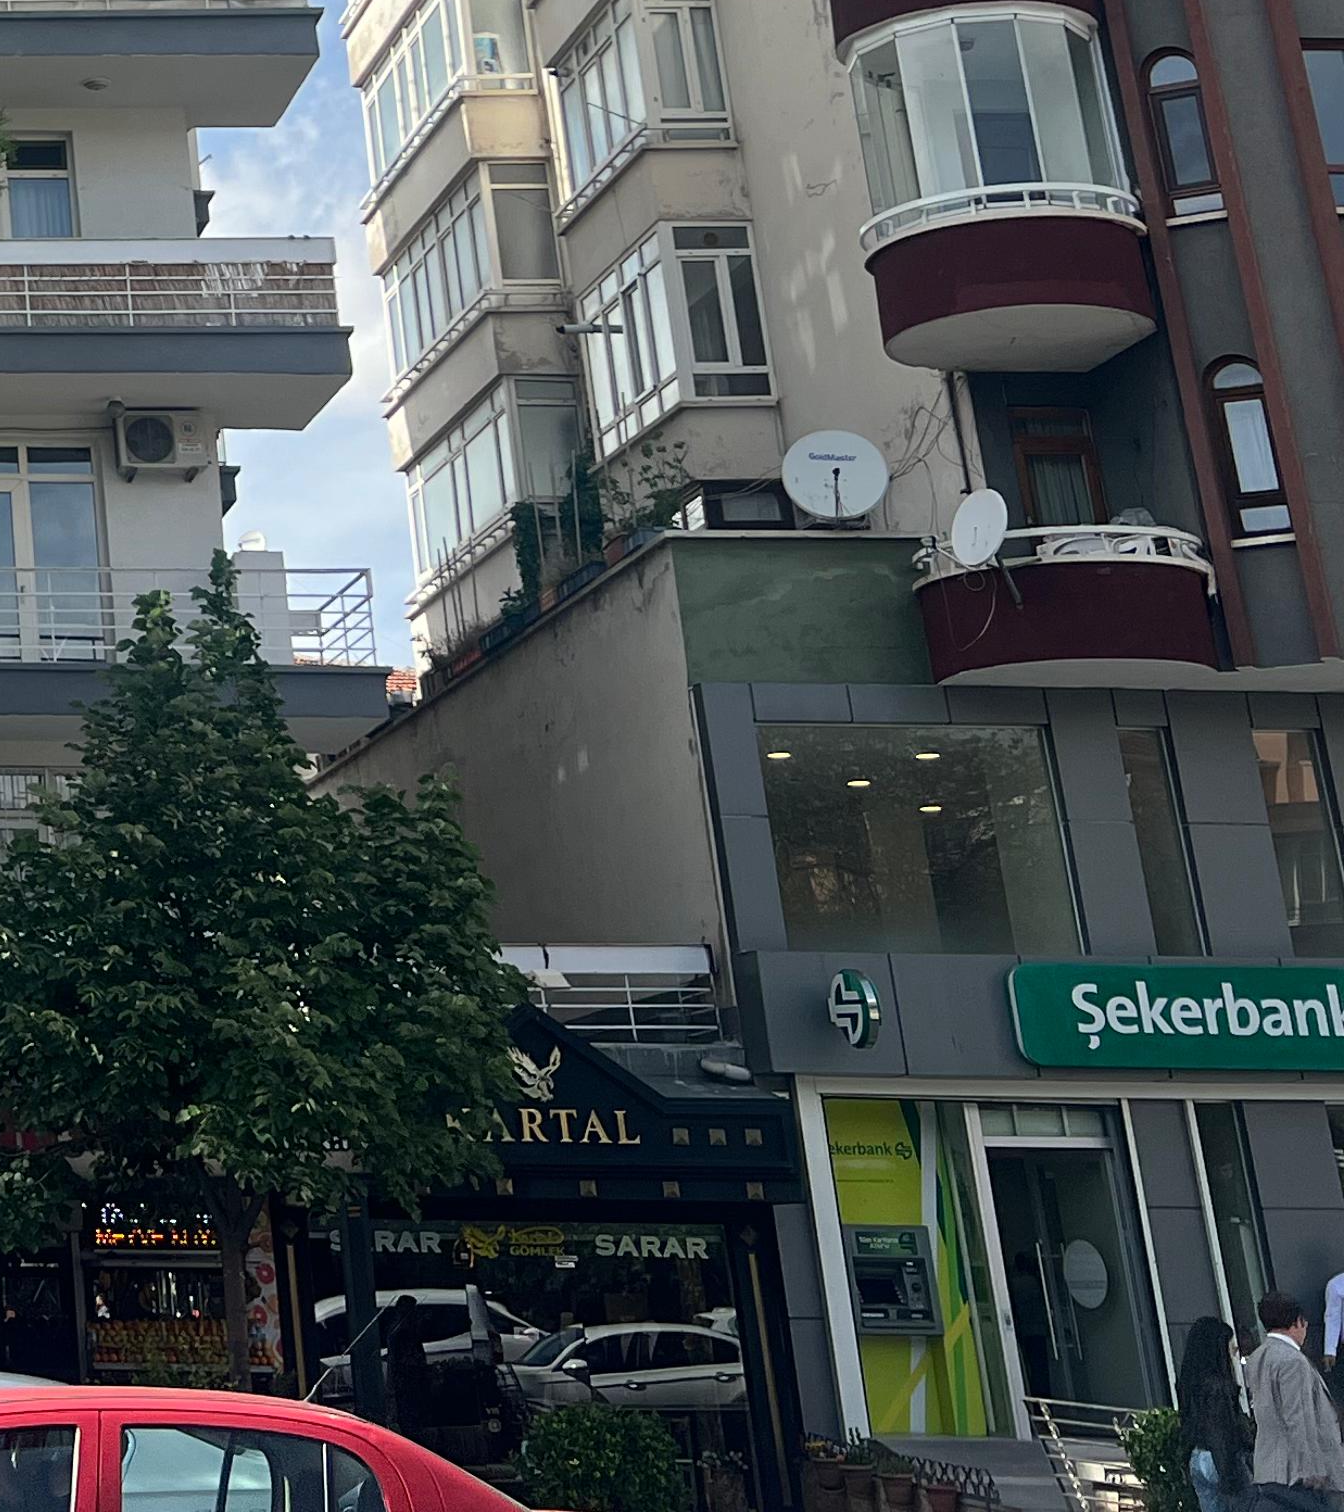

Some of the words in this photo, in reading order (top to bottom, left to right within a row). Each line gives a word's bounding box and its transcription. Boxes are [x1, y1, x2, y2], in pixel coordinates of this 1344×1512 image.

[1071, 981, 1344, 1050] Şekerbank
[829, 1141, 893, 1156] ekerbank
[329, 1228, 443, 1254] SRAR
[594, 1234, 709, 1259] SARAR
